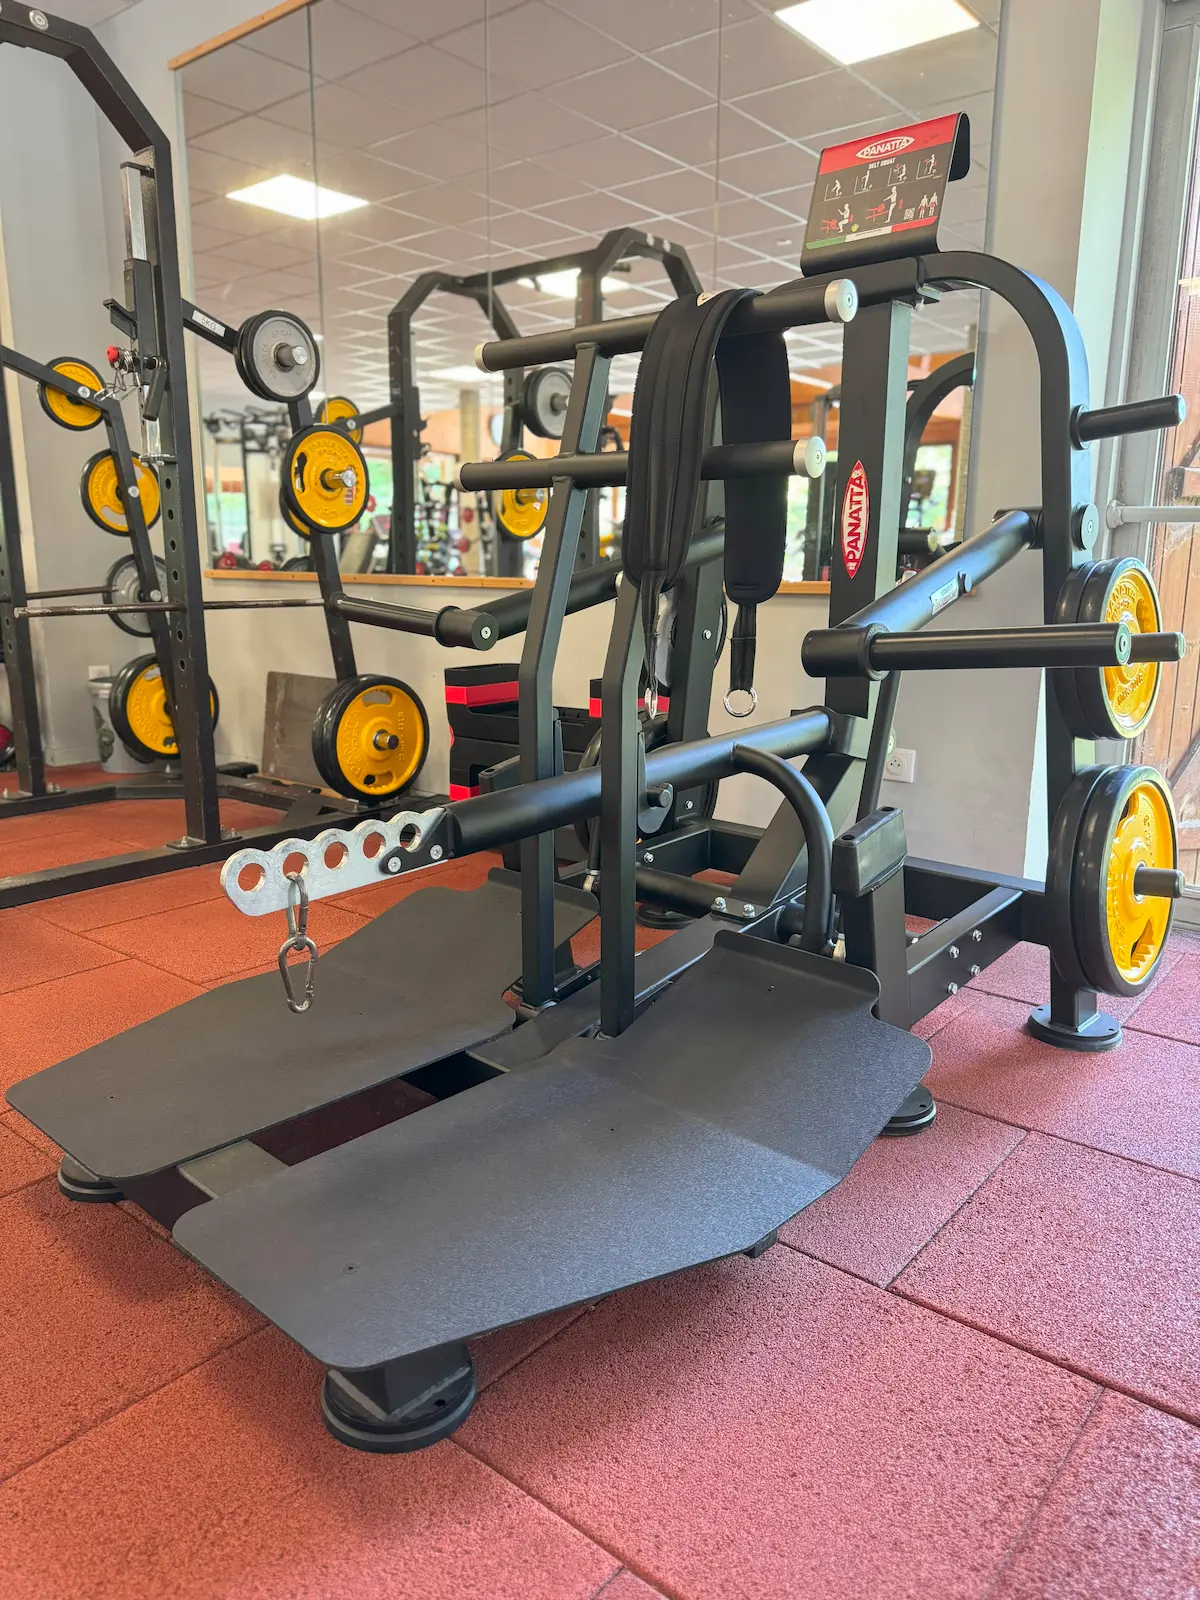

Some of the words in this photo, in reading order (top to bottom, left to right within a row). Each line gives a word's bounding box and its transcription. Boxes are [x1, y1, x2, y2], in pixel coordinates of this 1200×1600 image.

[863, 138, 909, 157] PANATTA
[868, 160, 881, 170] BELT
[880, 157, 896, 167] SQUAT
[199, 316, 217, 332] 5KG
[846, 474, 864, 561] PANATTA
